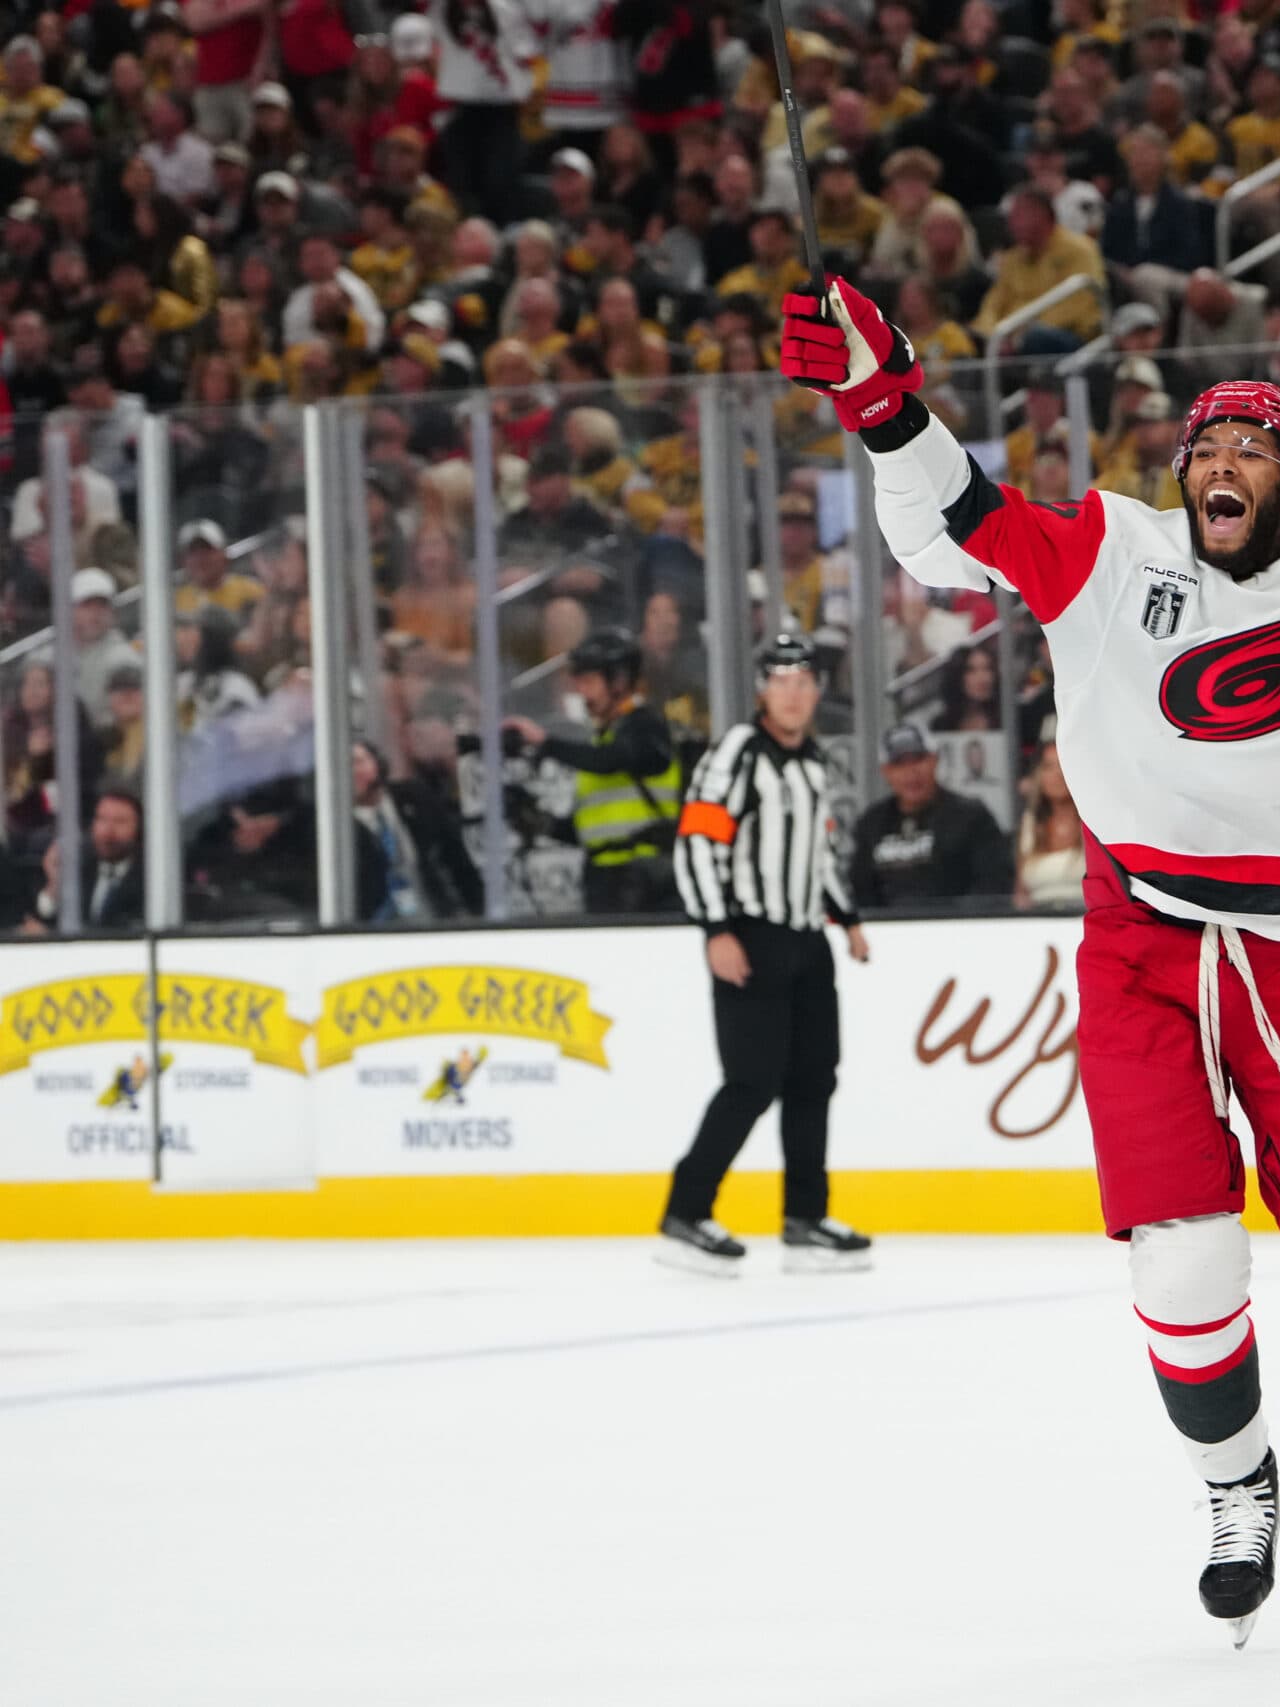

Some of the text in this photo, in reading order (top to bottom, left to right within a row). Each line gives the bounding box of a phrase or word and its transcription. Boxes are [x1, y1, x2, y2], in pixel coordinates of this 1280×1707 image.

[860, 397, 889, 420] MACH
[1143, 566, 1198, 586] NUCOR
[12, 979, 273, 1042] GOOD GREEK
[333, 974, 580, 1036] GOOD GREEK
[67, 1123, 195, 1154] OFFICIAL
[402, 1118, 512, 1149] MOVERS
